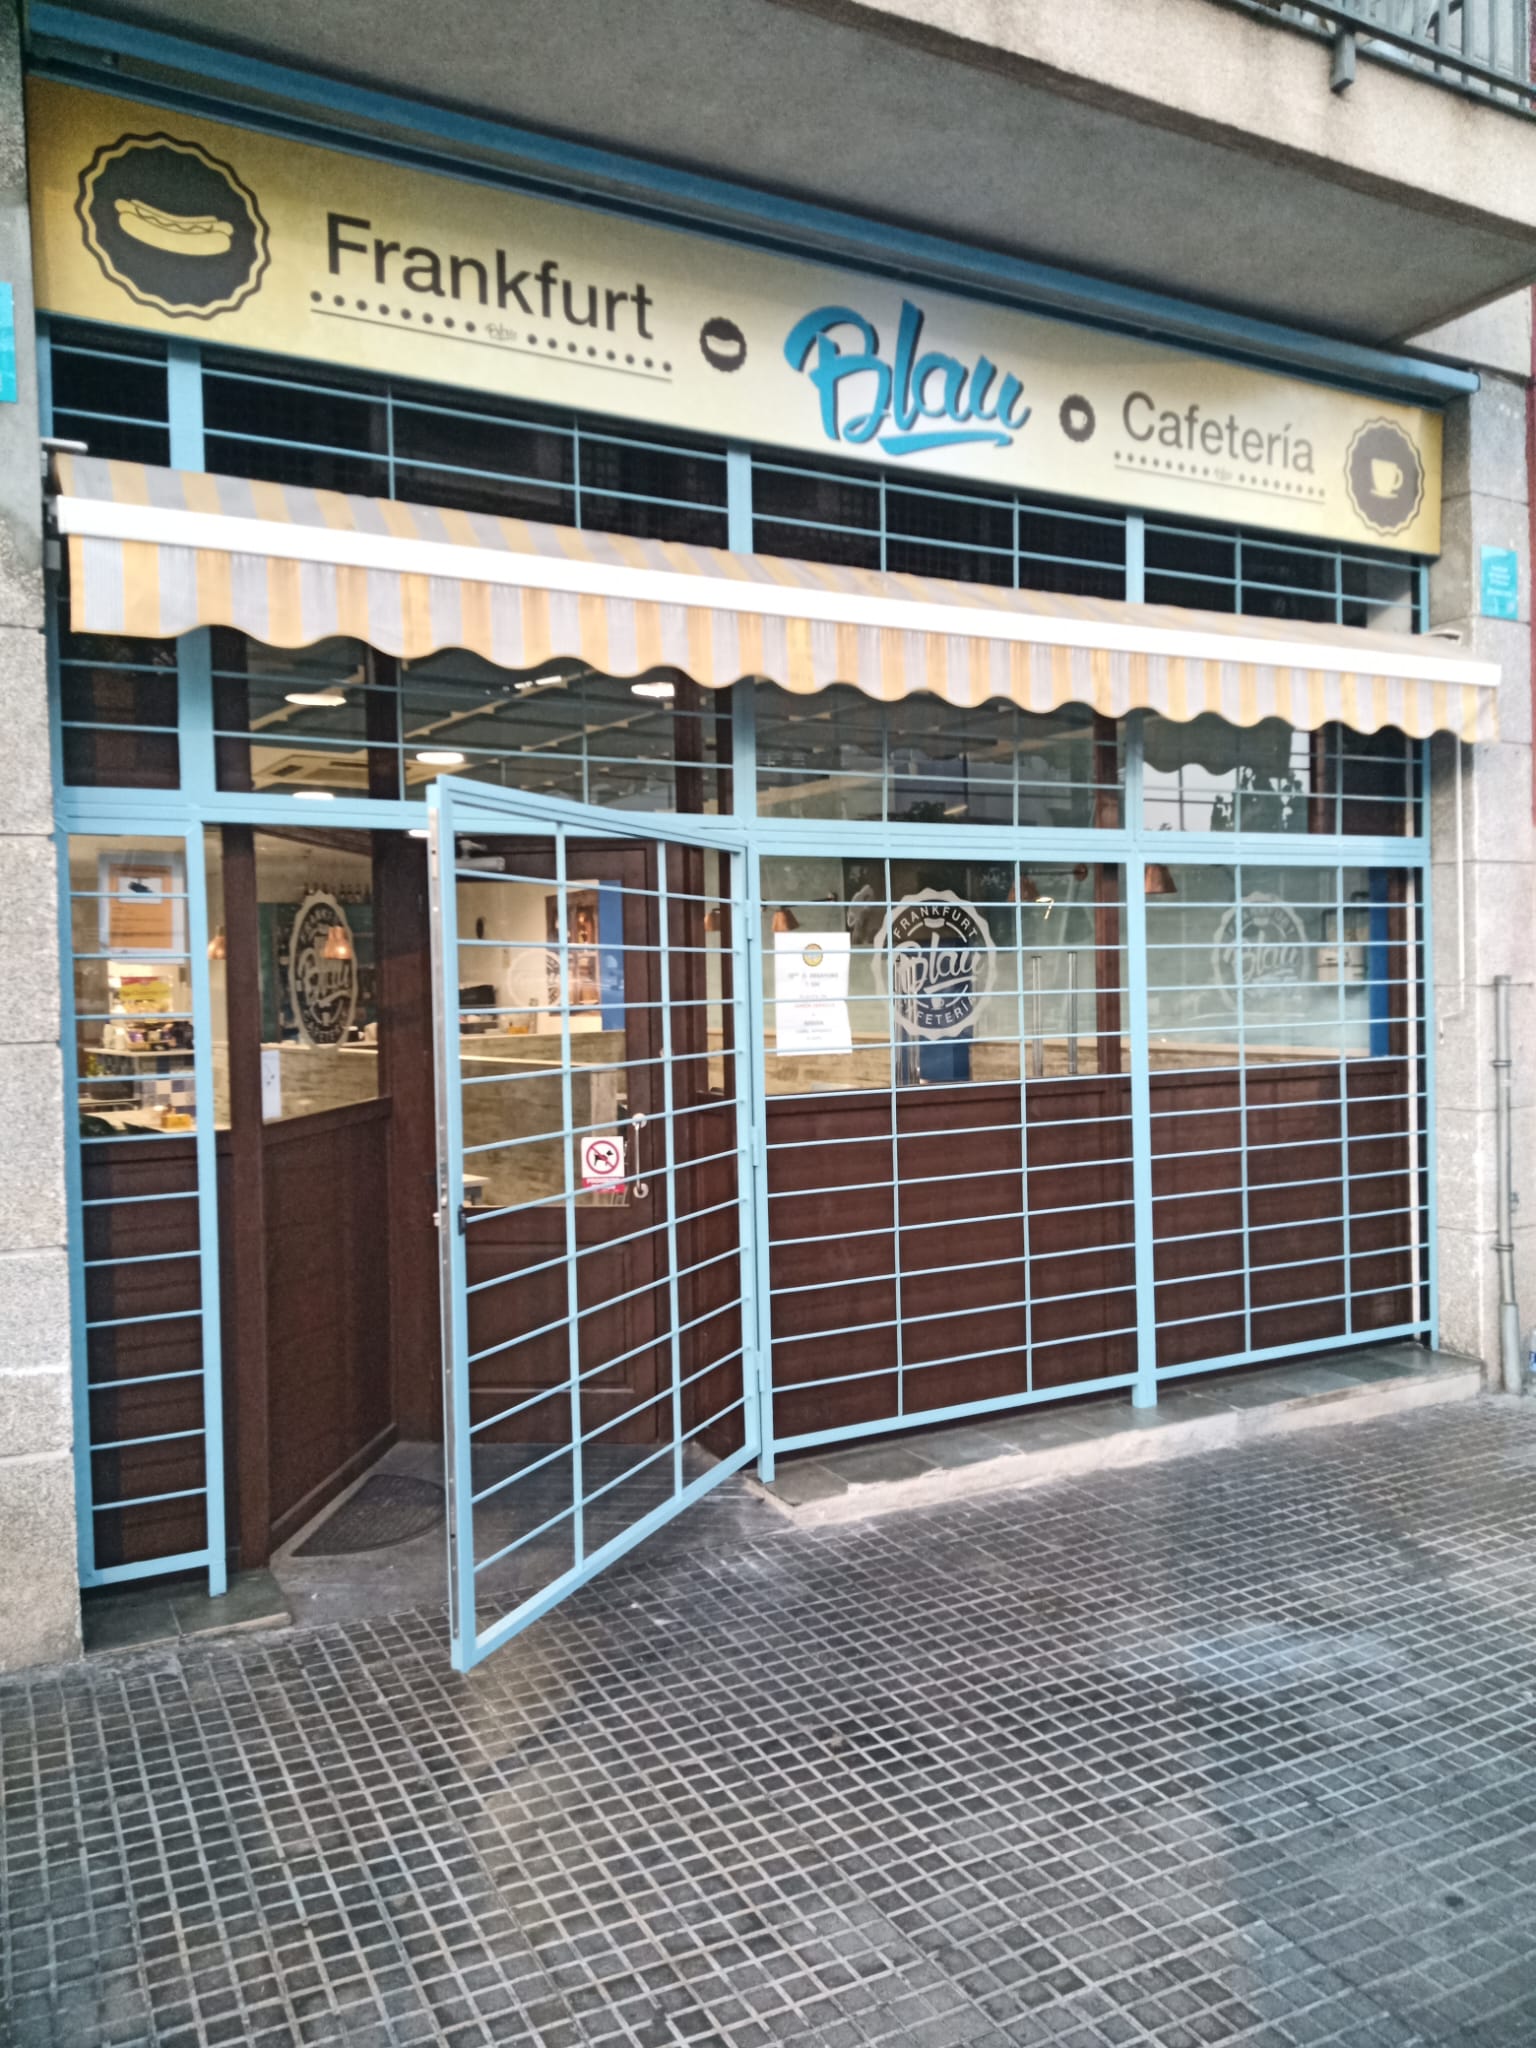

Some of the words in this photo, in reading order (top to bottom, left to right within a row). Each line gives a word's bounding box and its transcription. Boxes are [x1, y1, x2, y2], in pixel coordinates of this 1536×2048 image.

[327, 211, 654, 340] Frankfurt
[783, 298, 1032, 449] Blau
[1122, 390, 1315, 475] Cafetería
[893, 905, 978, 940] FRANKFURT
[894, 931, 985, 994] Blau
